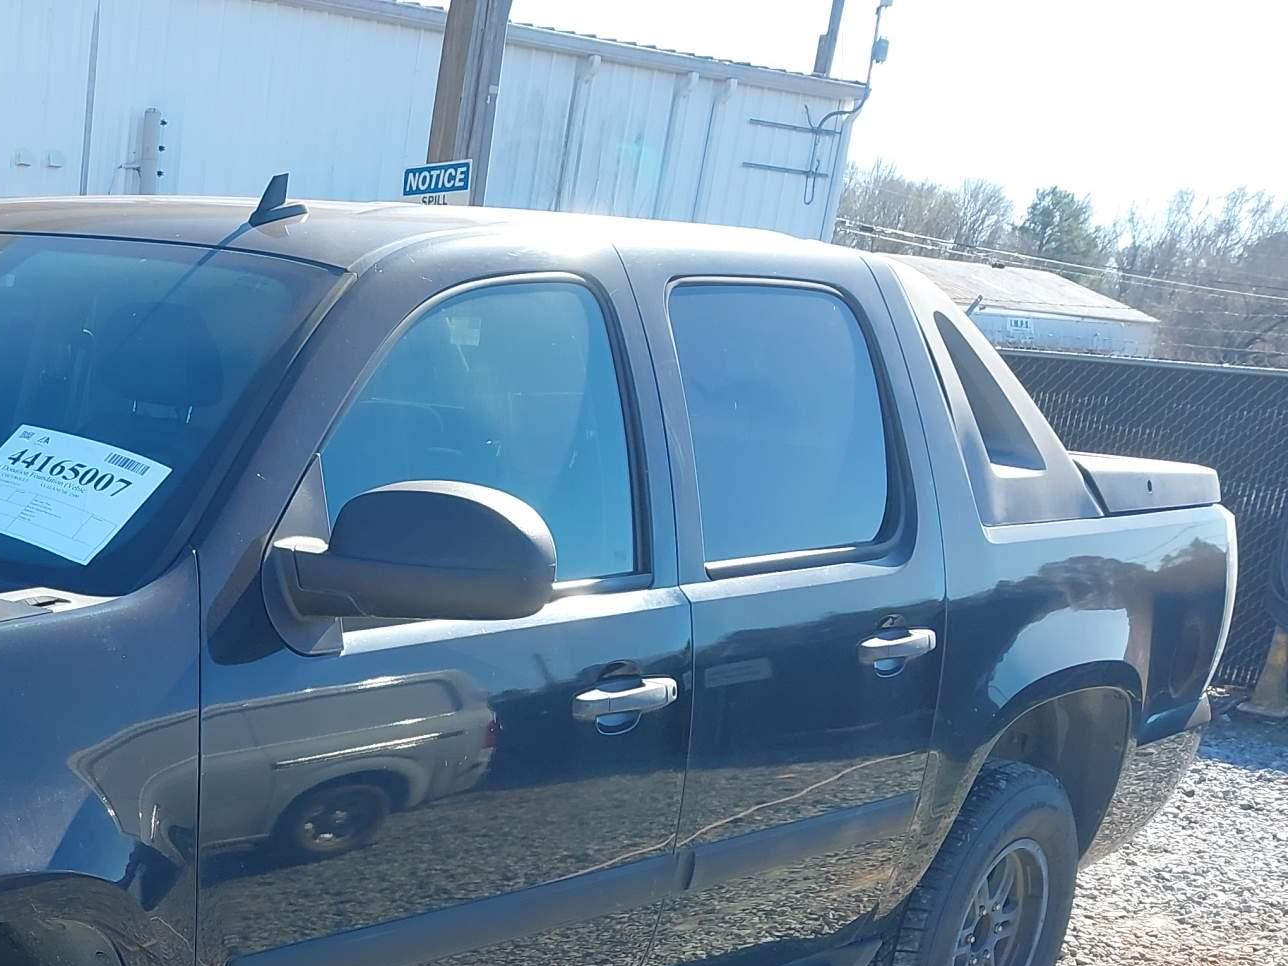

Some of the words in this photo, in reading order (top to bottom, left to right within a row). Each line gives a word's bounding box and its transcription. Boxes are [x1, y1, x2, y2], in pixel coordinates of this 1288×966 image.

[405, 166, 468, 192] NOTICE
[421, 193, 448, 206] SPILL
[7, 448, 133, 497] 44165007
